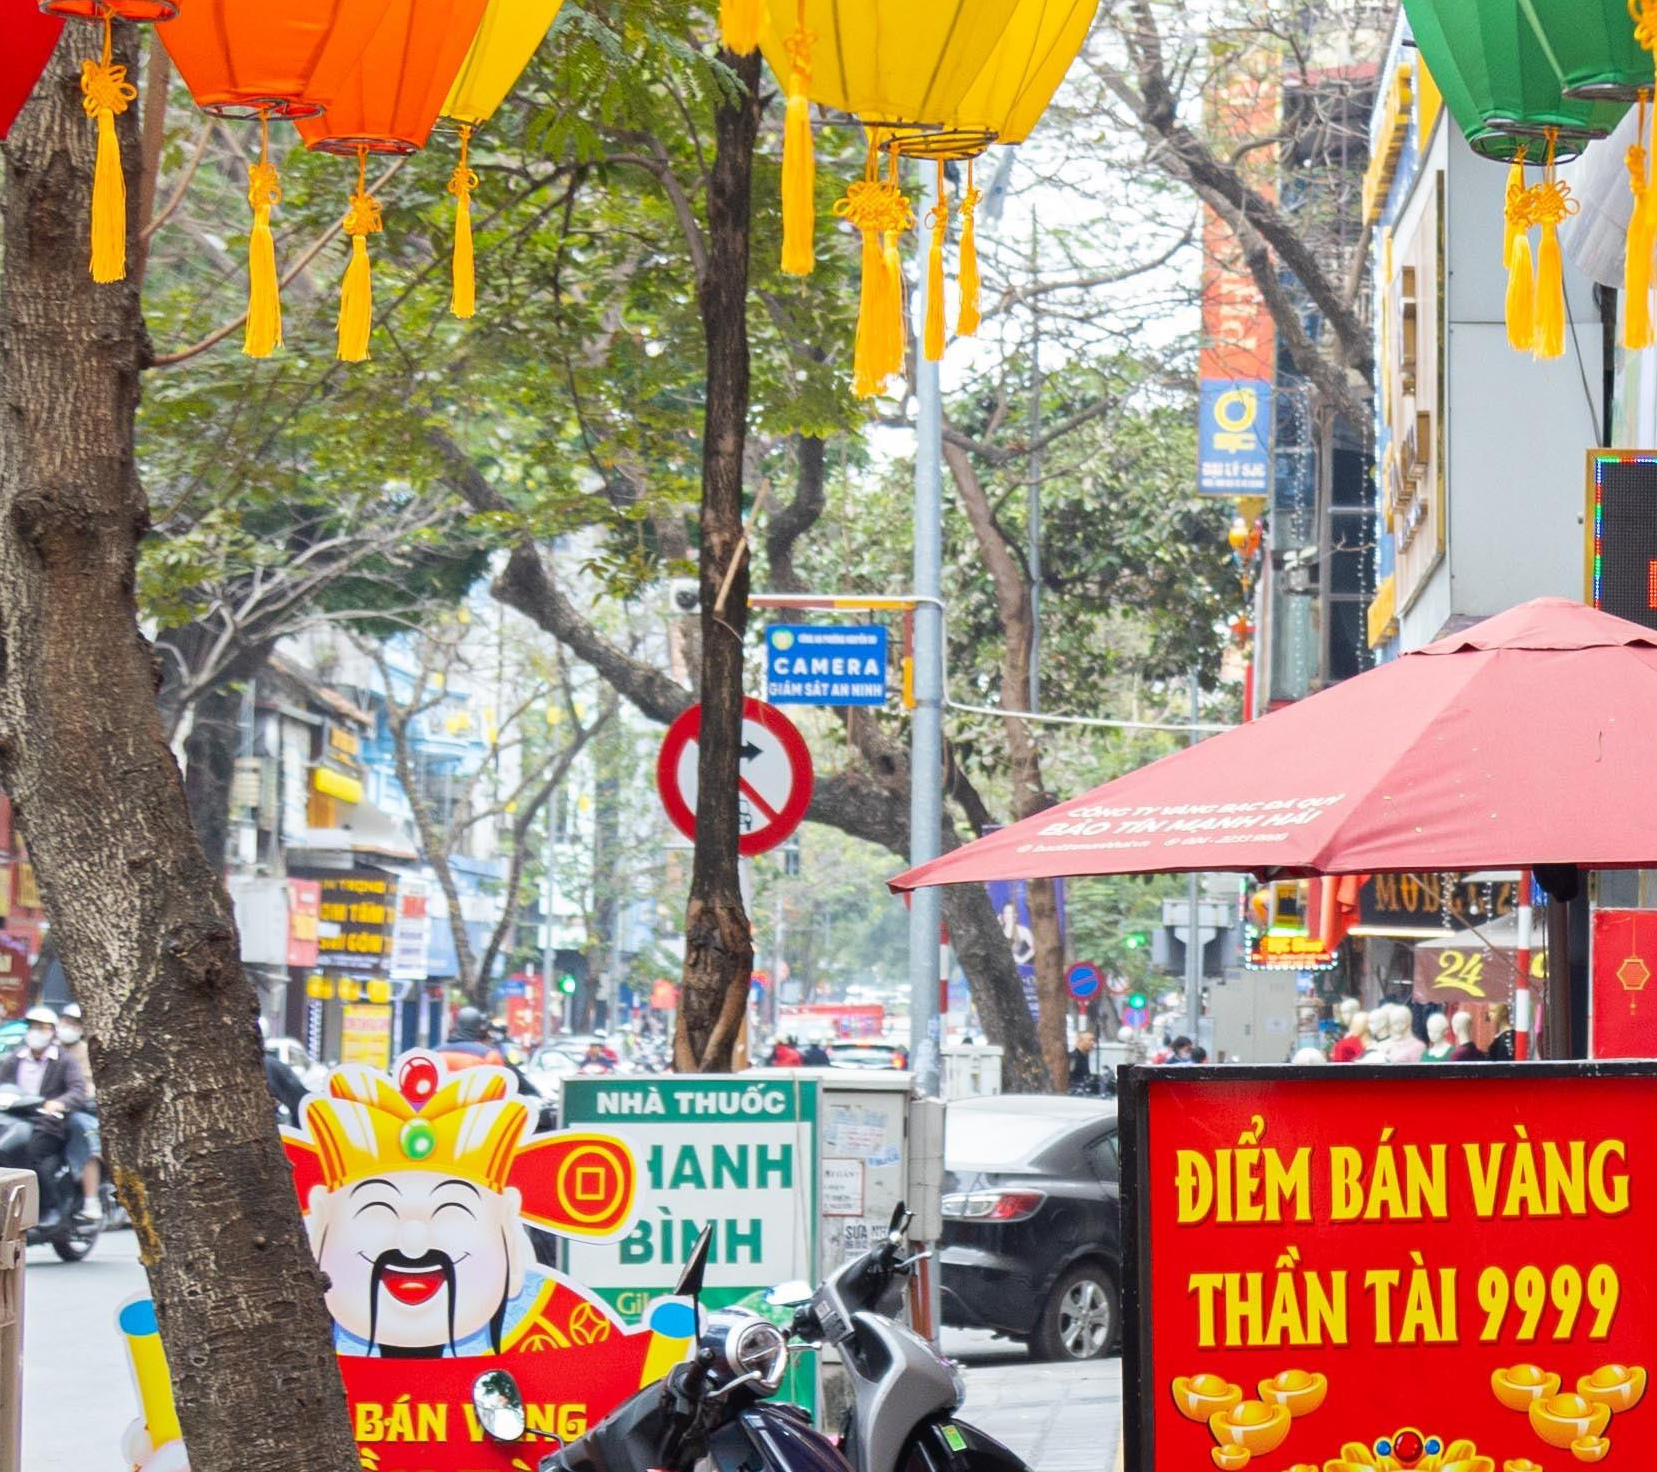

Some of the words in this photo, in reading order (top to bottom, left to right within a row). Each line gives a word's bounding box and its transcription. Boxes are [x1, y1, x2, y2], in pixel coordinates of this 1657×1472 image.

[773, 657, 881, 677] CAMERA
[1037, 818, 1112, 838] BẢO
[1113, 818, 1166, 835] TÍN
[1165, 815, 1261, 835] MẠNH
[1260, 808, 1324, 827] HẢI
[596, 1086, 666, 1115] NHÀ
[674, 1084, 786, 1115] THUỐC
[646, 1143, 793, 1190] HANH
[1175, 1113, 1314, 1224] ĐIỂM
[1329, 1127, 1448, 1222] BÁN
[1461, 1124, 1631, 1218] VÀNG
[618, 1205, 763, 1265] BÌNH
[1187, 1245, 1348, 1349] THẦN
[1364, 1253, 1459, 1346] TÀI
[1476, 1263, 1620, 1342] 9999
[354, 1392, 448, 1443] BÁN
